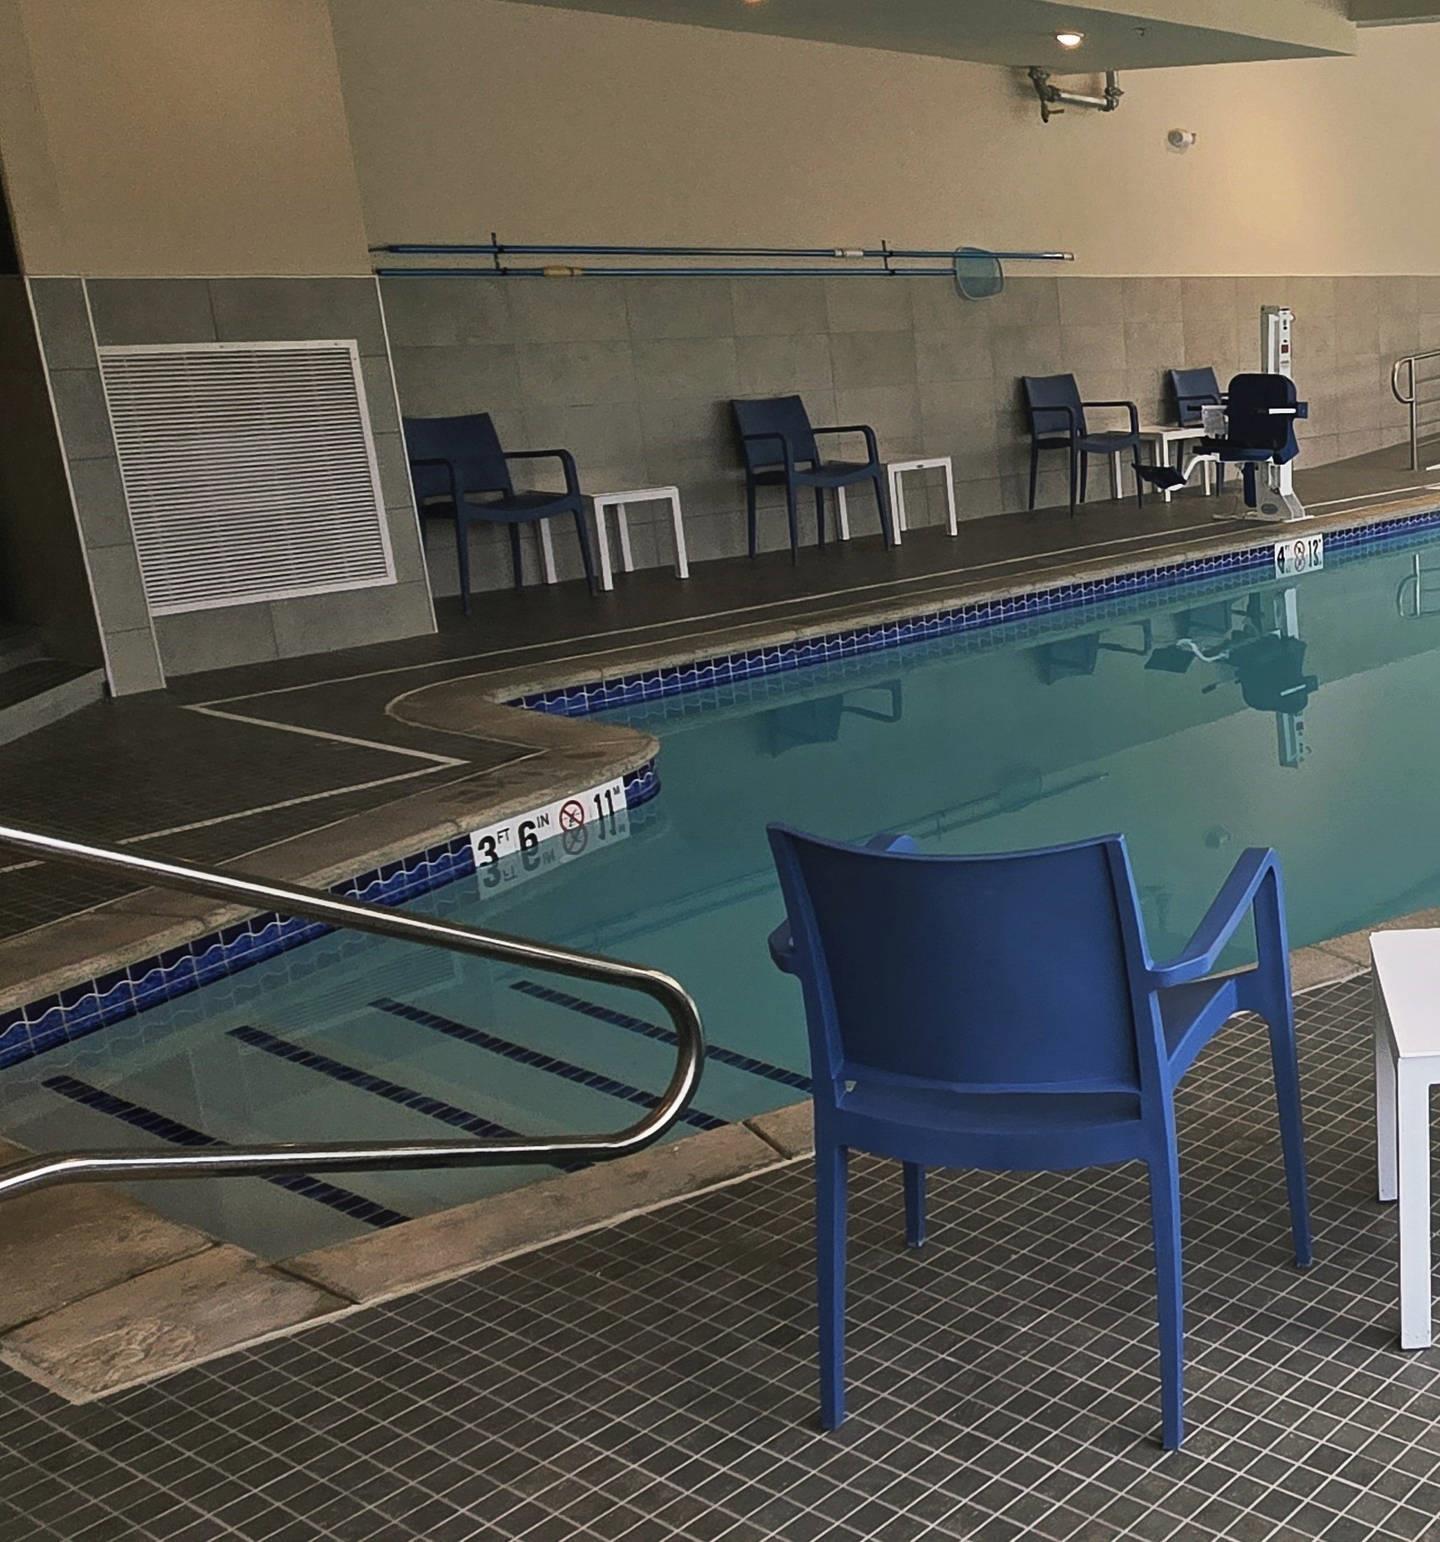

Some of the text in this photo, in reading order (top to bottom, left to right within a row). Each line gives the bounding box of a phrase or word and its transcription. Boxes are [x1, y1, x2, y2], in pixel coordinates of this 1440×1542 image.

[1277, 546, 1285, 561] 4
[478, 836, 498, 867] 3
[498, 828, 510, 843] FT
[518, 820, 539, 855] 6
[538, 813, 549, 828] IN
